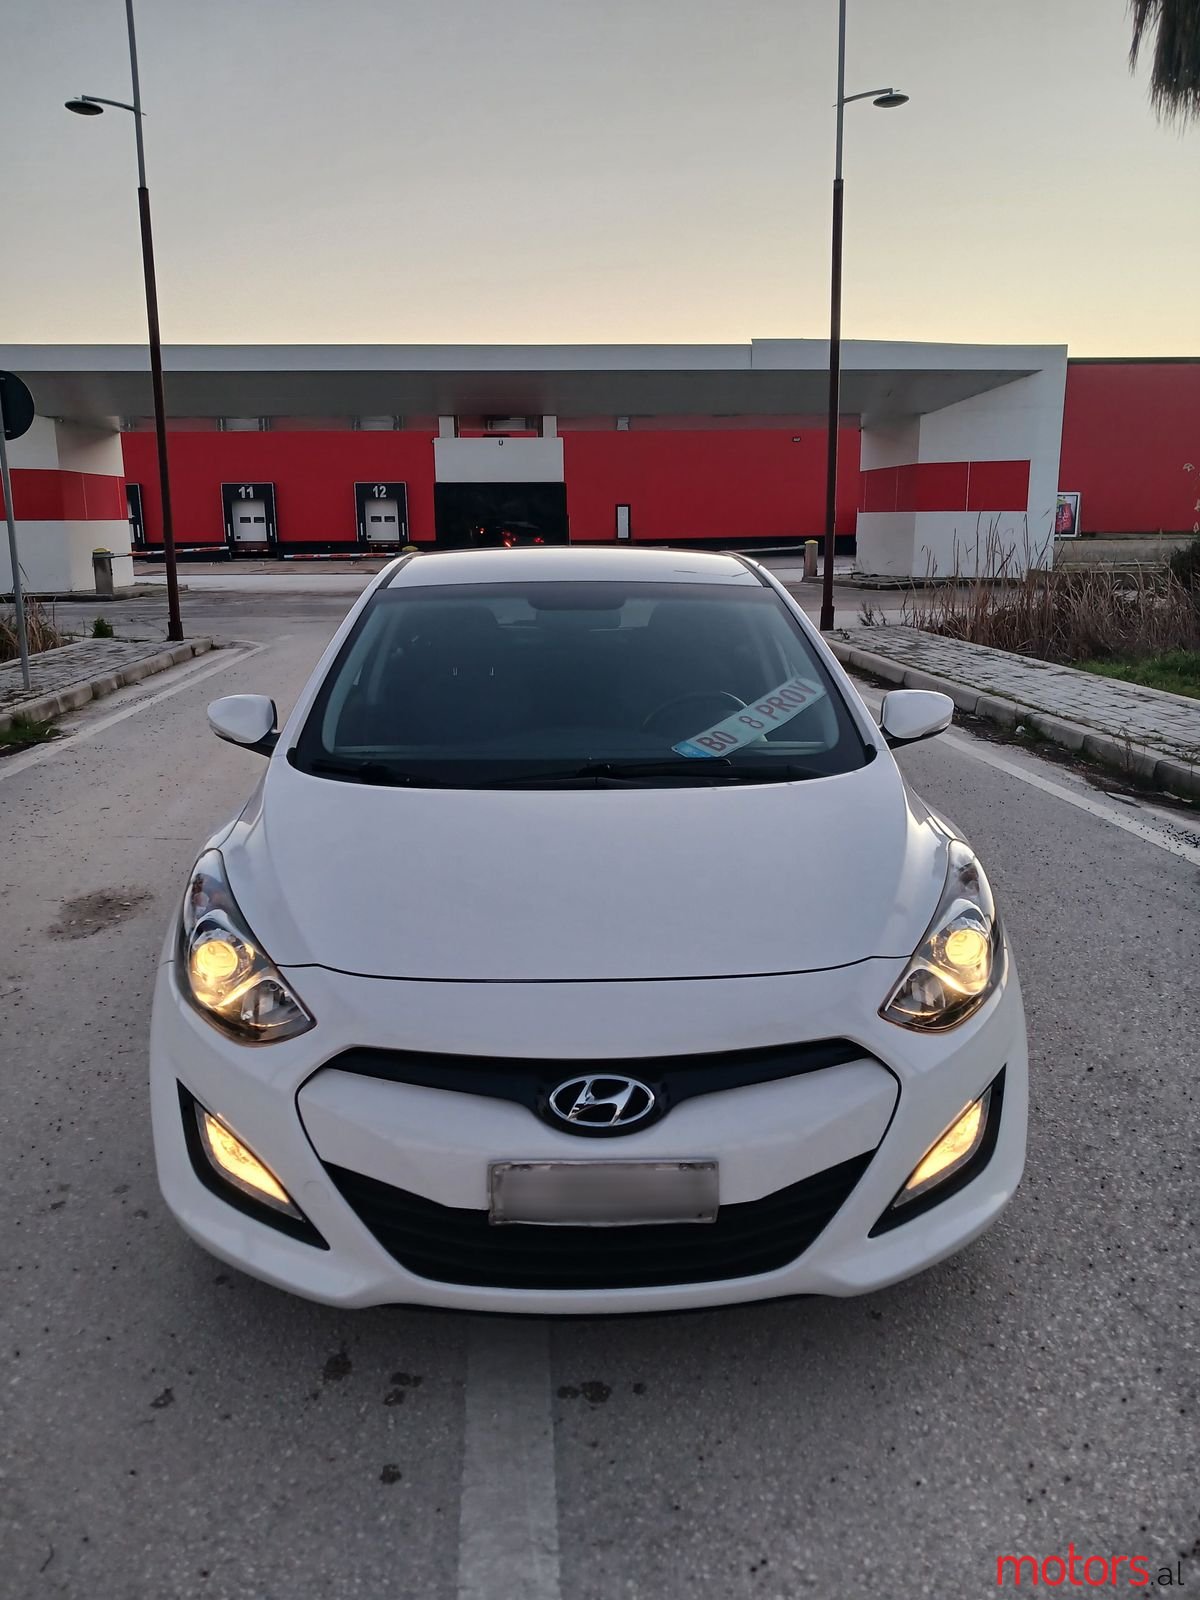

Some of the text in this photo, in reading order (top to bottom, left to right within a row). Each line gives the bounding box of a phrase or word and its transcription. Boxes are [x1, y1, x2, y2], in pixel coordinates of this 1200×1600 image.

[238, 486, 254, 499] 11
[372, 485, 387, 498] 12
[739, 716, 765, 729] 8
[756, 680, 817, 720] PROV
